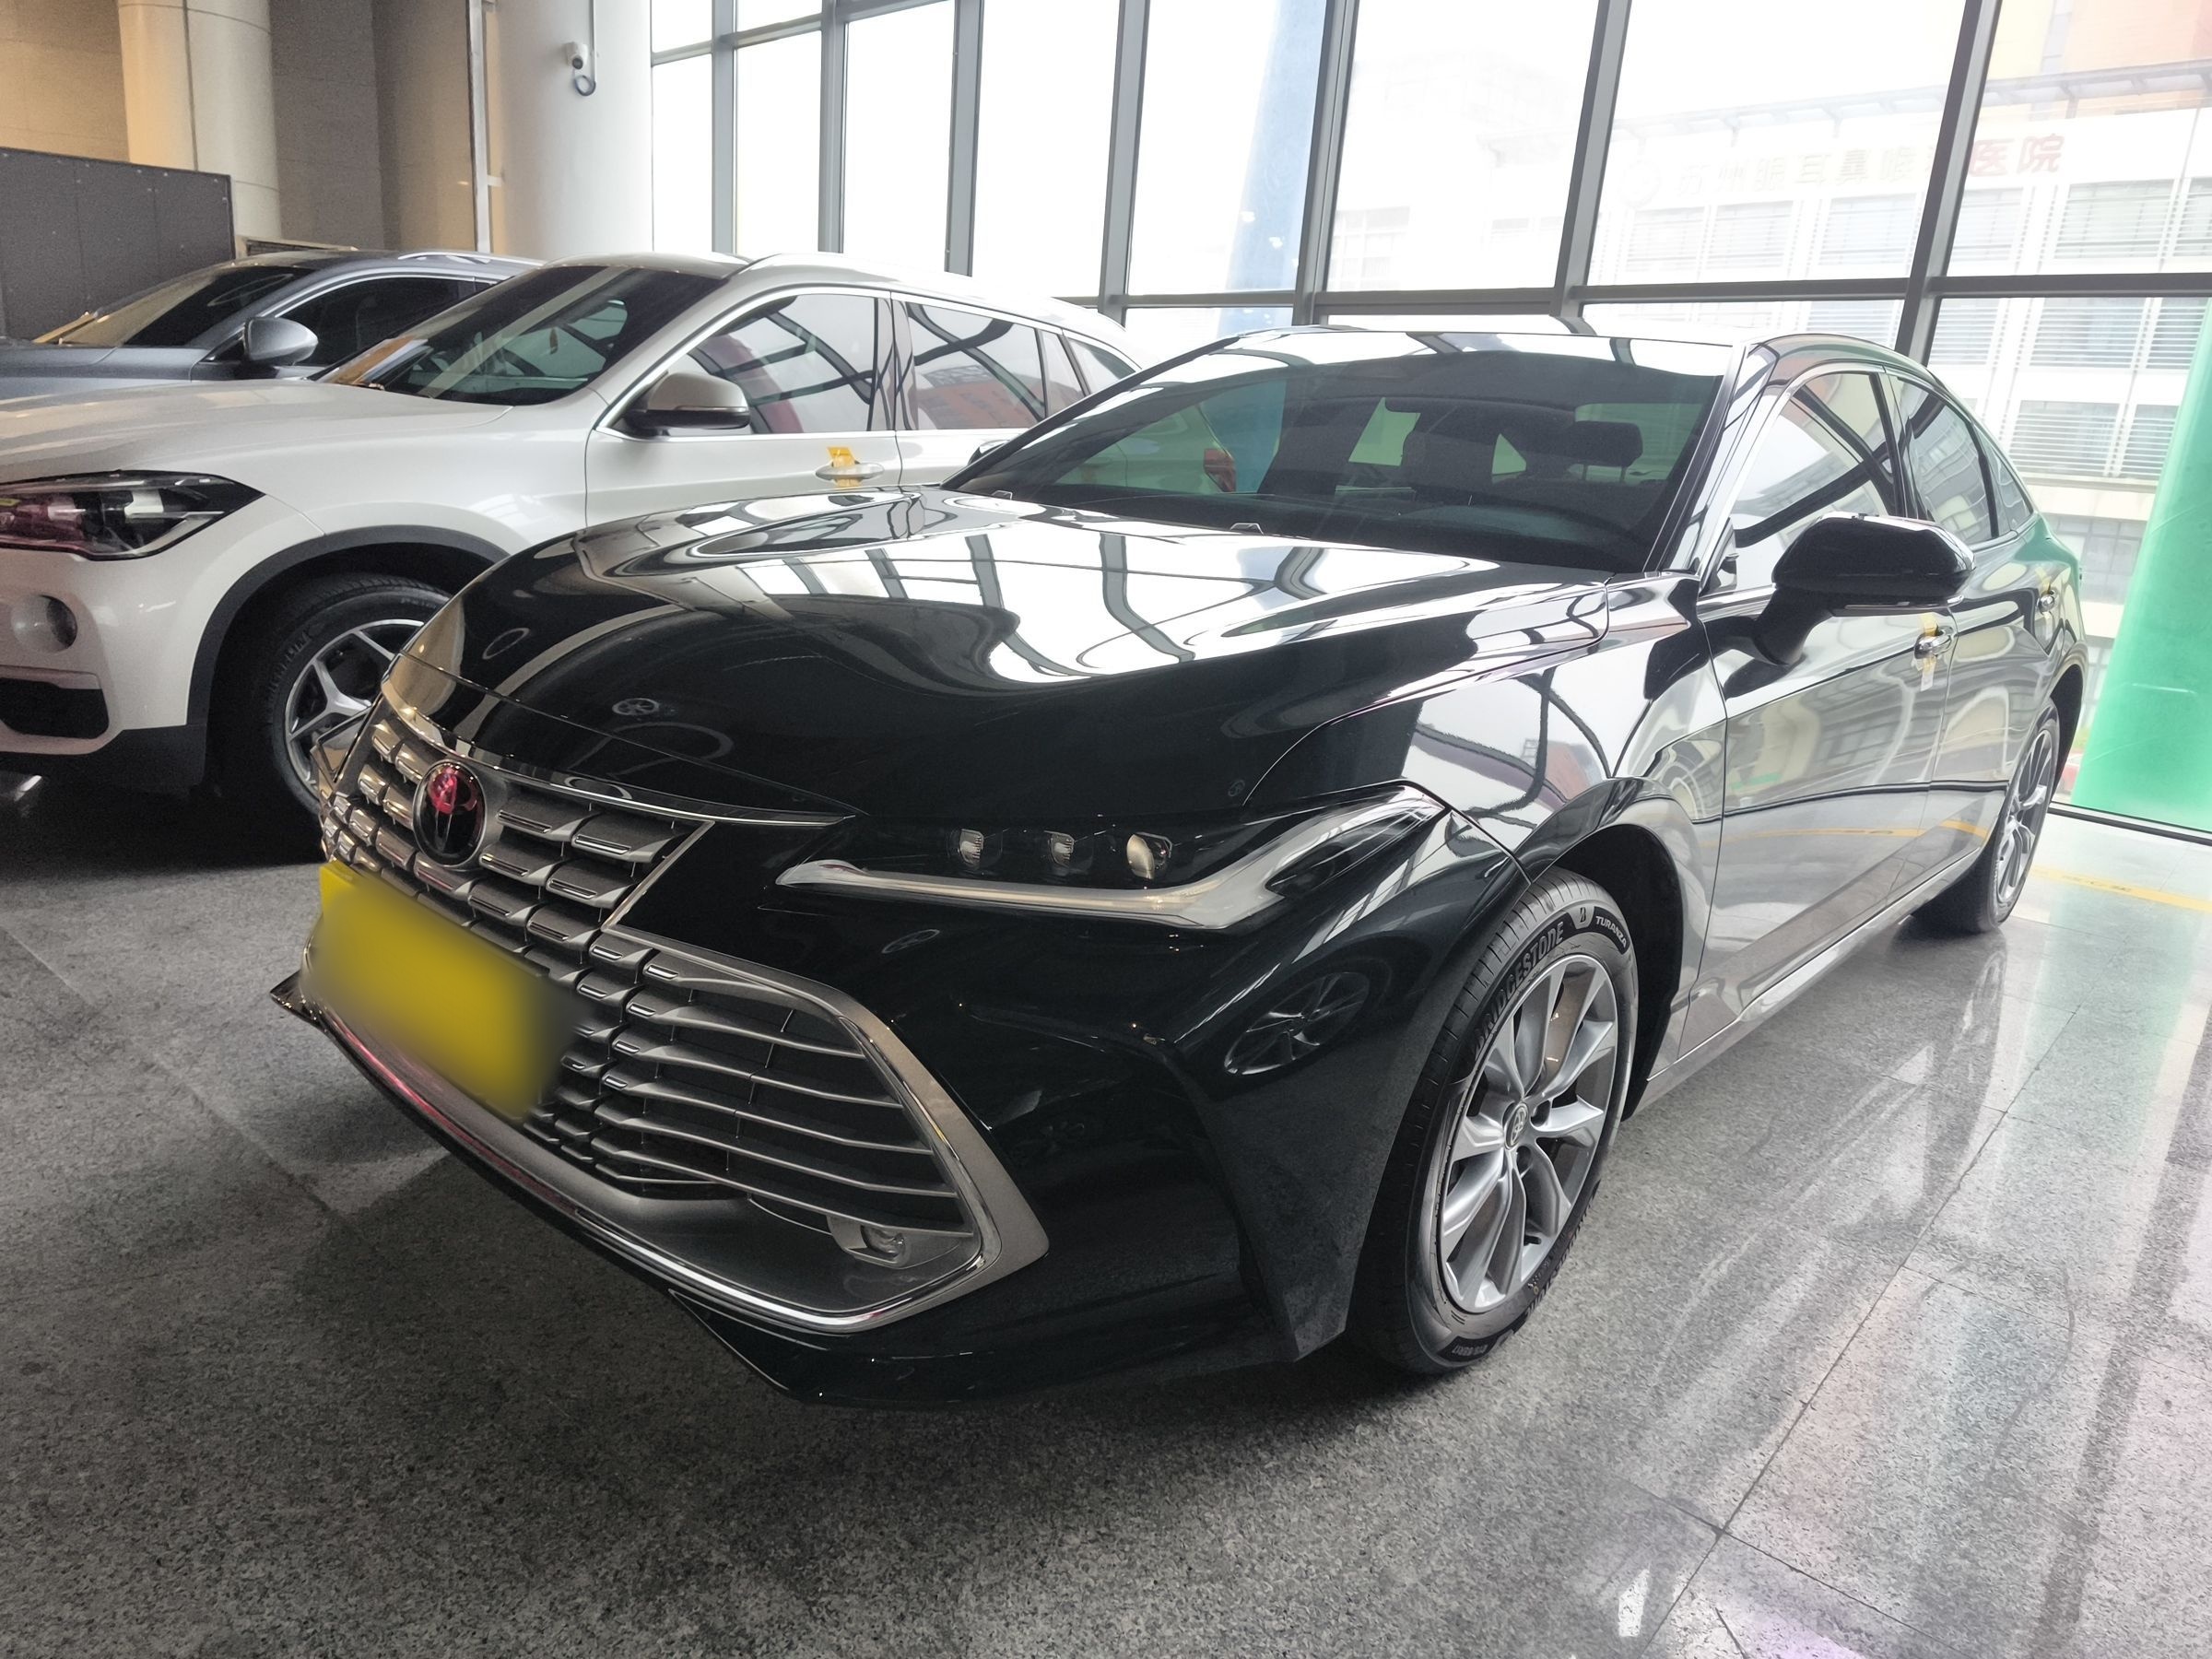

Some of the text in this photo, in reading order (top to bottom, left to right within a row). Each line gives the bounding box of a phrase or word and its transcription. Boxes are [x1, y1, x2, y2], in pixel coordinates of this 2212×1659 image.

[1677, 135, 2064, 194] 苏州眼耳鼻喉医院
[1473, 920, 1565, 1060] BRIDGESTONE
[1594, 915, 1628, 949] TURANZA
